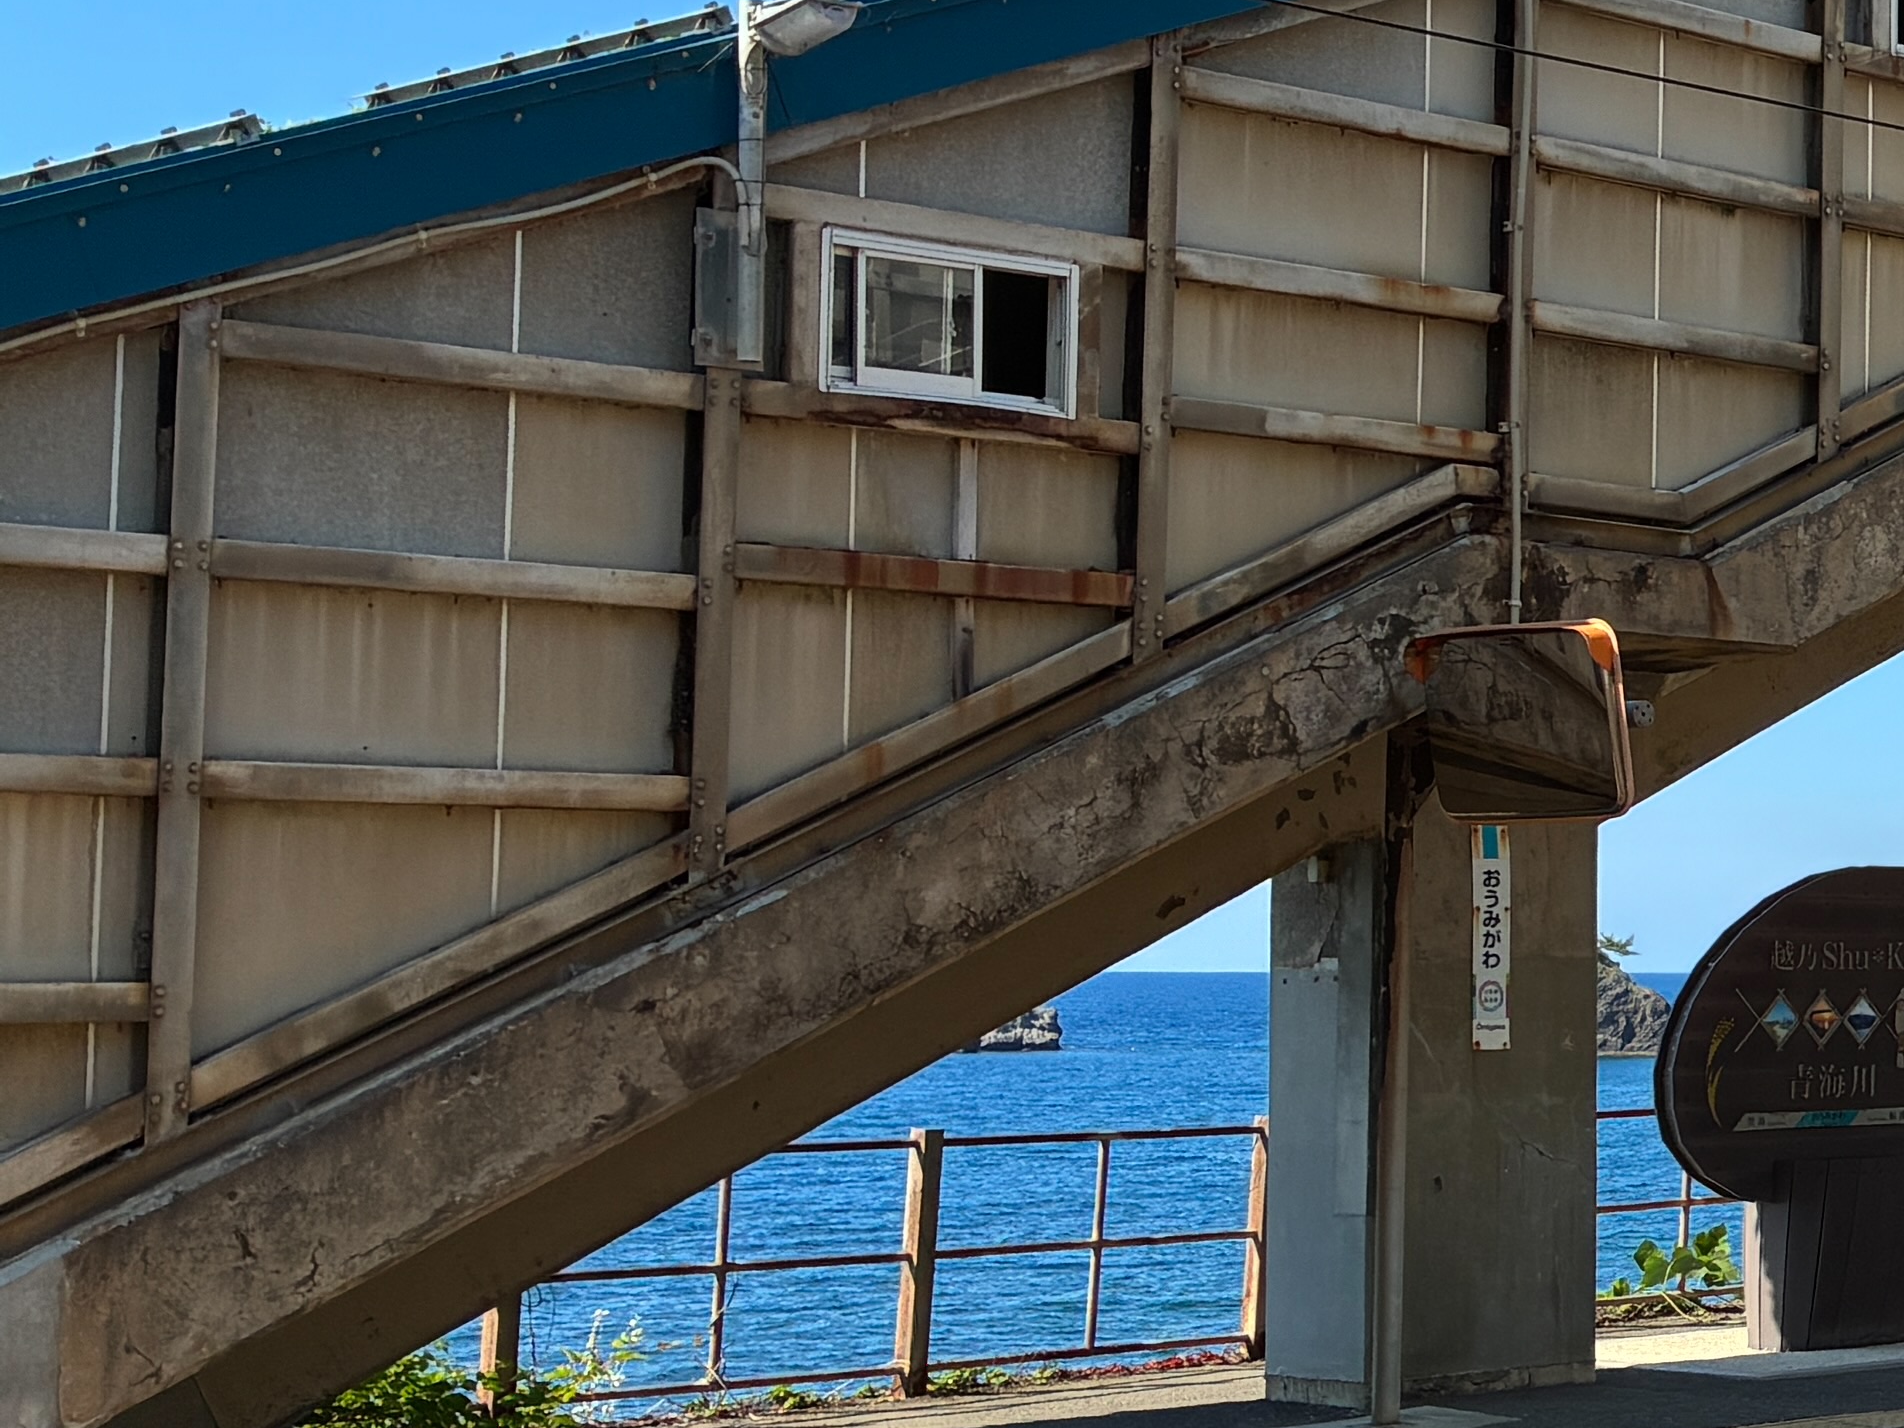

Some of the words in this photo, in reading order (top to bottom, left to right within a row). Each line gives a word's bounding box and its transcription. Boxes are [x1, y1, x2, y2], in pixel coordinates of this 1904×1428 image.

[1482, 869, 1502, 969] おうみがわ
[1789, 1063, 1877, 1100] 青海川
